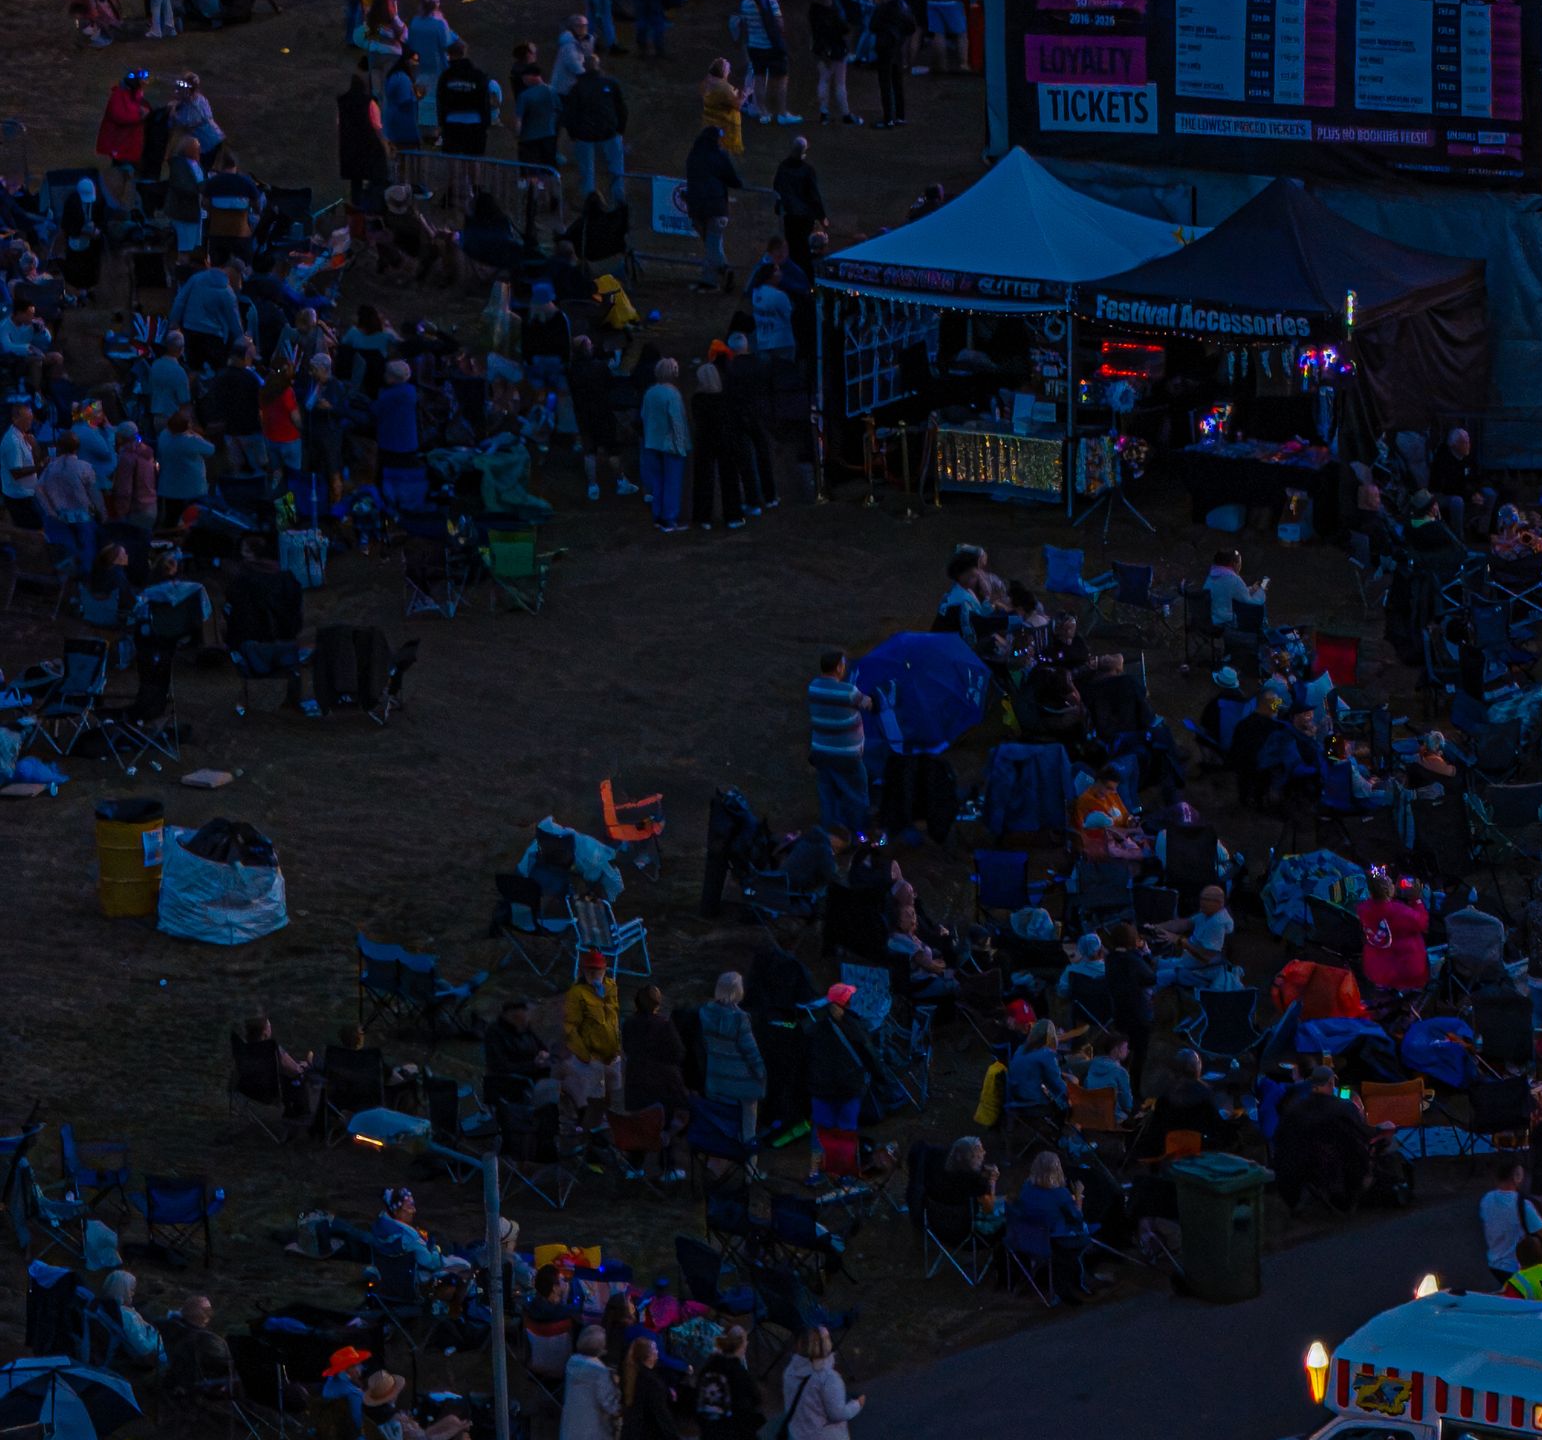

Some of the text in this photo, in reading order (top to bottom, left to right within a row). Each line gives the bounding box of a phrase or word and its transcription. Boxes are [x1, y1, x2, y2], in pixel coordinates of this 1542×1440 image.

[1040, 45, 1132, 75] LOYALTY
[1047, 90, 1149, 123] TICKETS
[1198, 118, 1231, 130] LOWEST
[1268, 123, 1306, 136] TICKETS
[1317, 128, 1340, 140] PLUS
[1095, 293, 1311, 337] Festival Accessories
